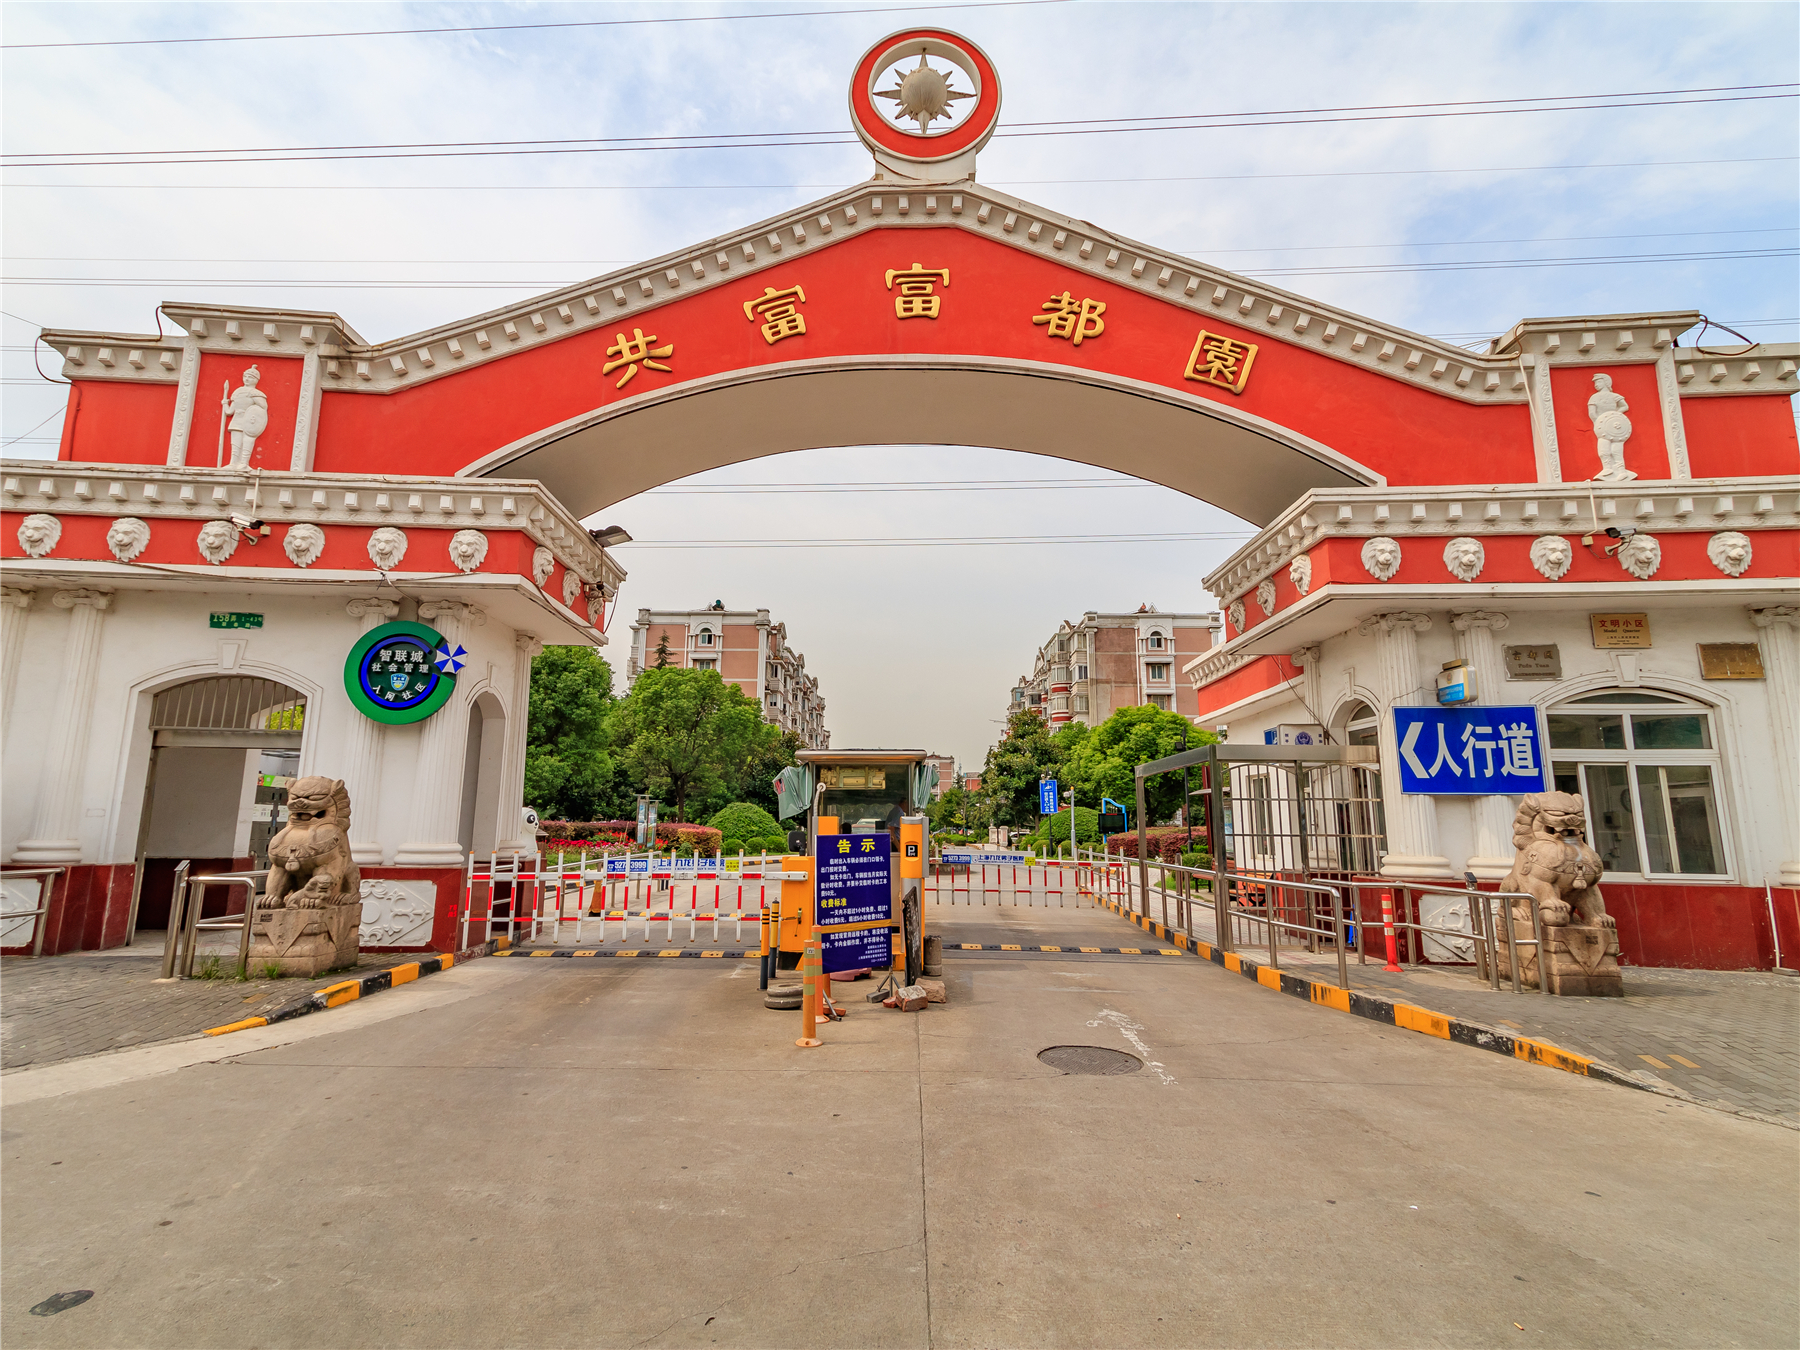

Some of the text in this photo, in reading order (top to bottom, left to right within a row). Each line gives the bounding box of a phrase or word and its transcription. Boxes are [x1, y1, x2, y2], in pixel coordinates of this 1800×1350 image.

[1598, 619, 1644, 628] 文明小区
[379, 649, 425, 663] 智联城
[371, 663, 429, 674] 社会管理
[1428, 722, 1539, 778] 人行道
[837, 838, 876, 854] 告示
[614, 861, 647, 869] 527 3999
[820, 897, 847, 909] 收费标准
